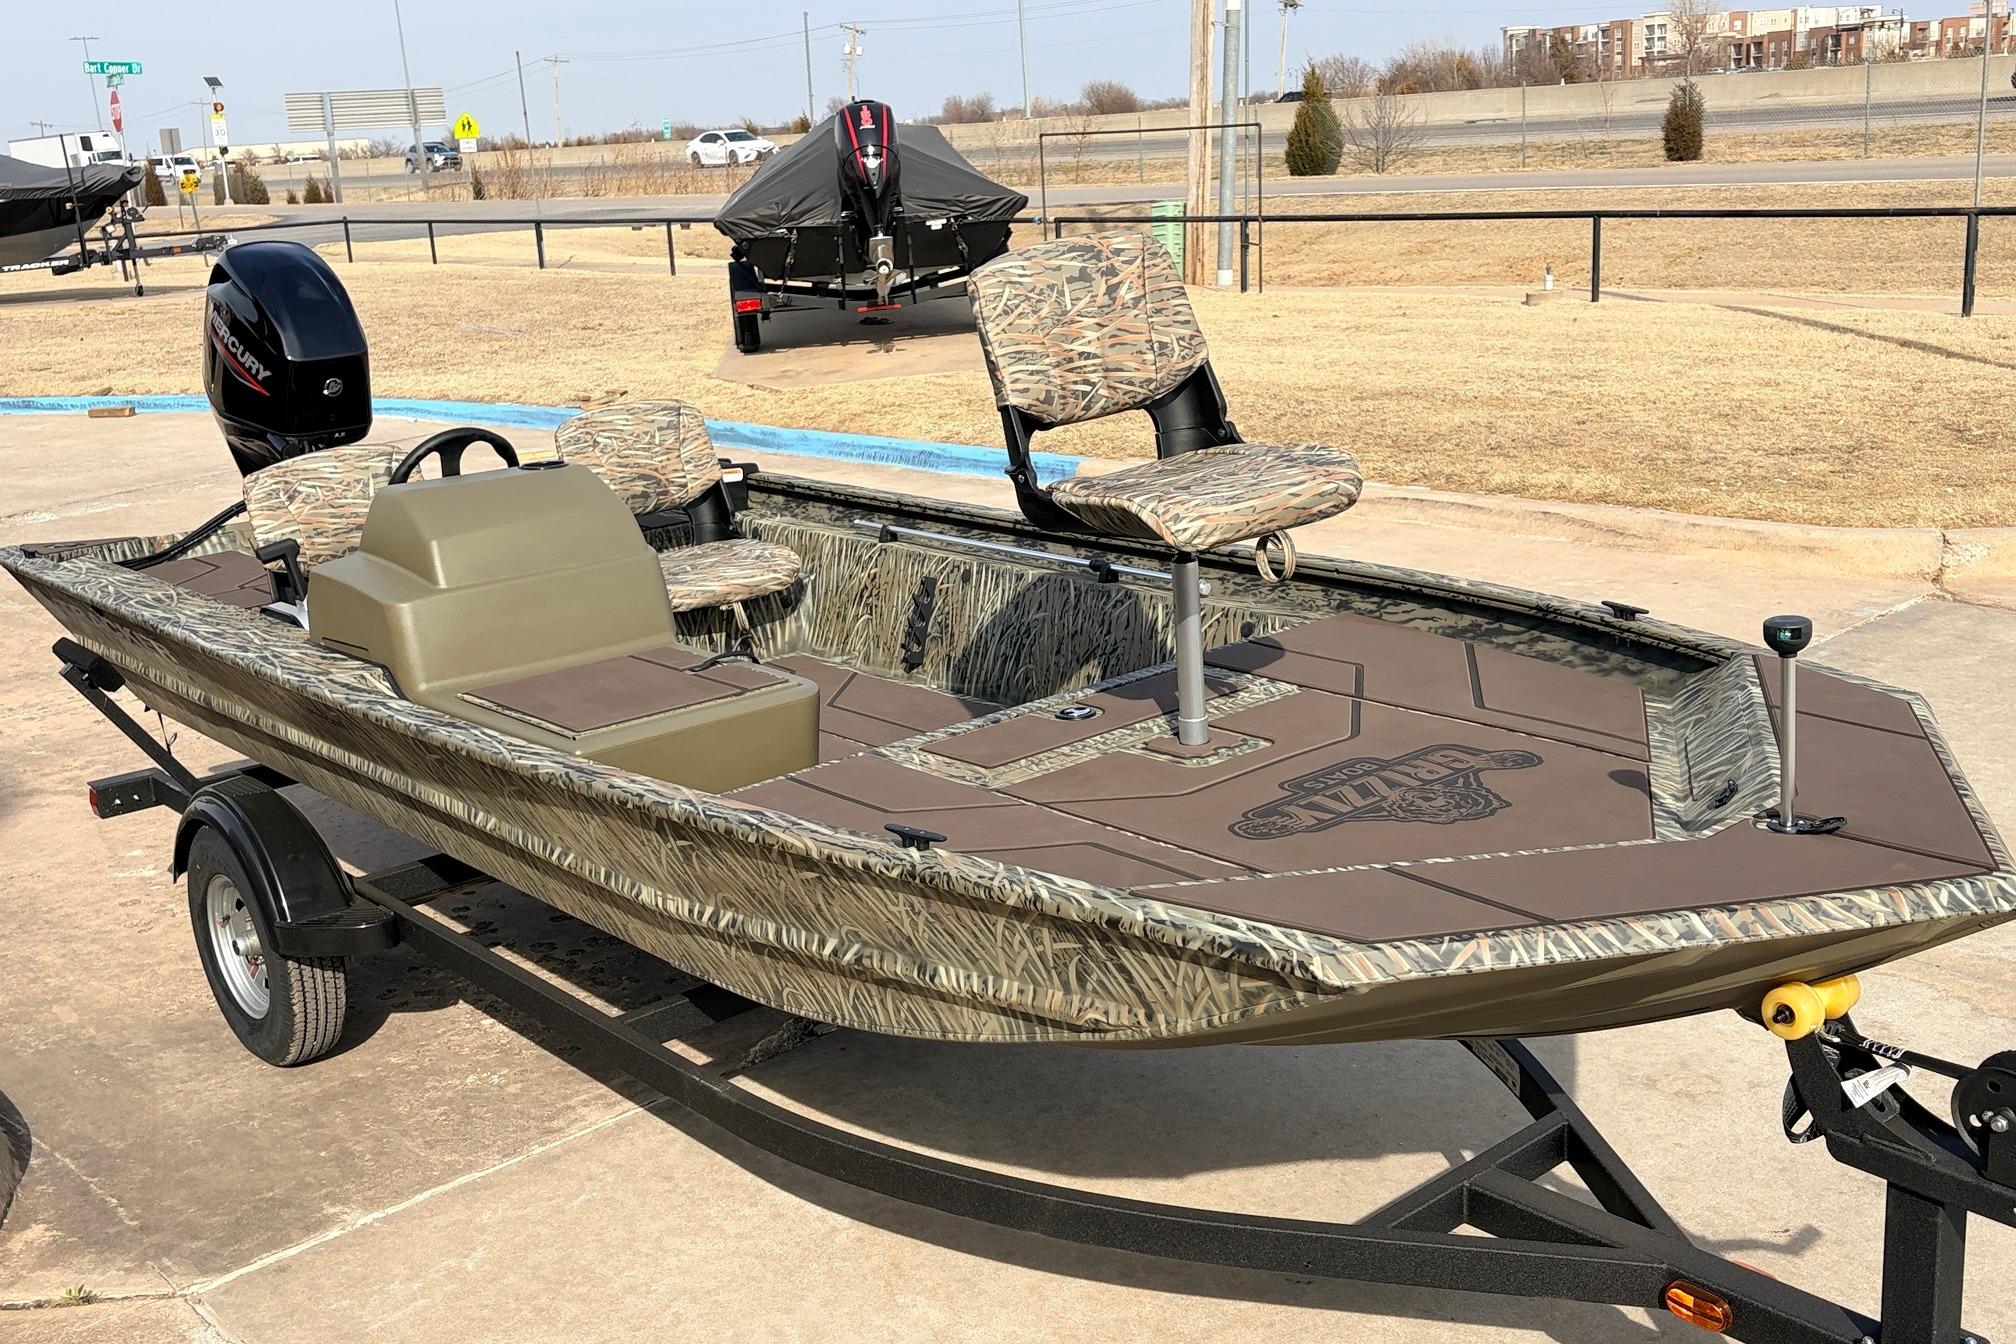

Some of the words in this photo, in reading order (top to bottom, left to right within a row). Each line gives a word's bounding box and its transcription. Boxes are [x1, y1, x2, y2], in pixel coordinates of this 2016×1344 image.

[84, 62, 101, 73] Bart
[104, 62, 129, 74] Conner
[131, 63, 141, 73] Dr
[214, 128, 226, 136] 30
[1, 259, 70, 272] TRACKER
[1303, 762, 1380, 789] BOATS
[1280, 751, 1473, 827] GRIZZLY
